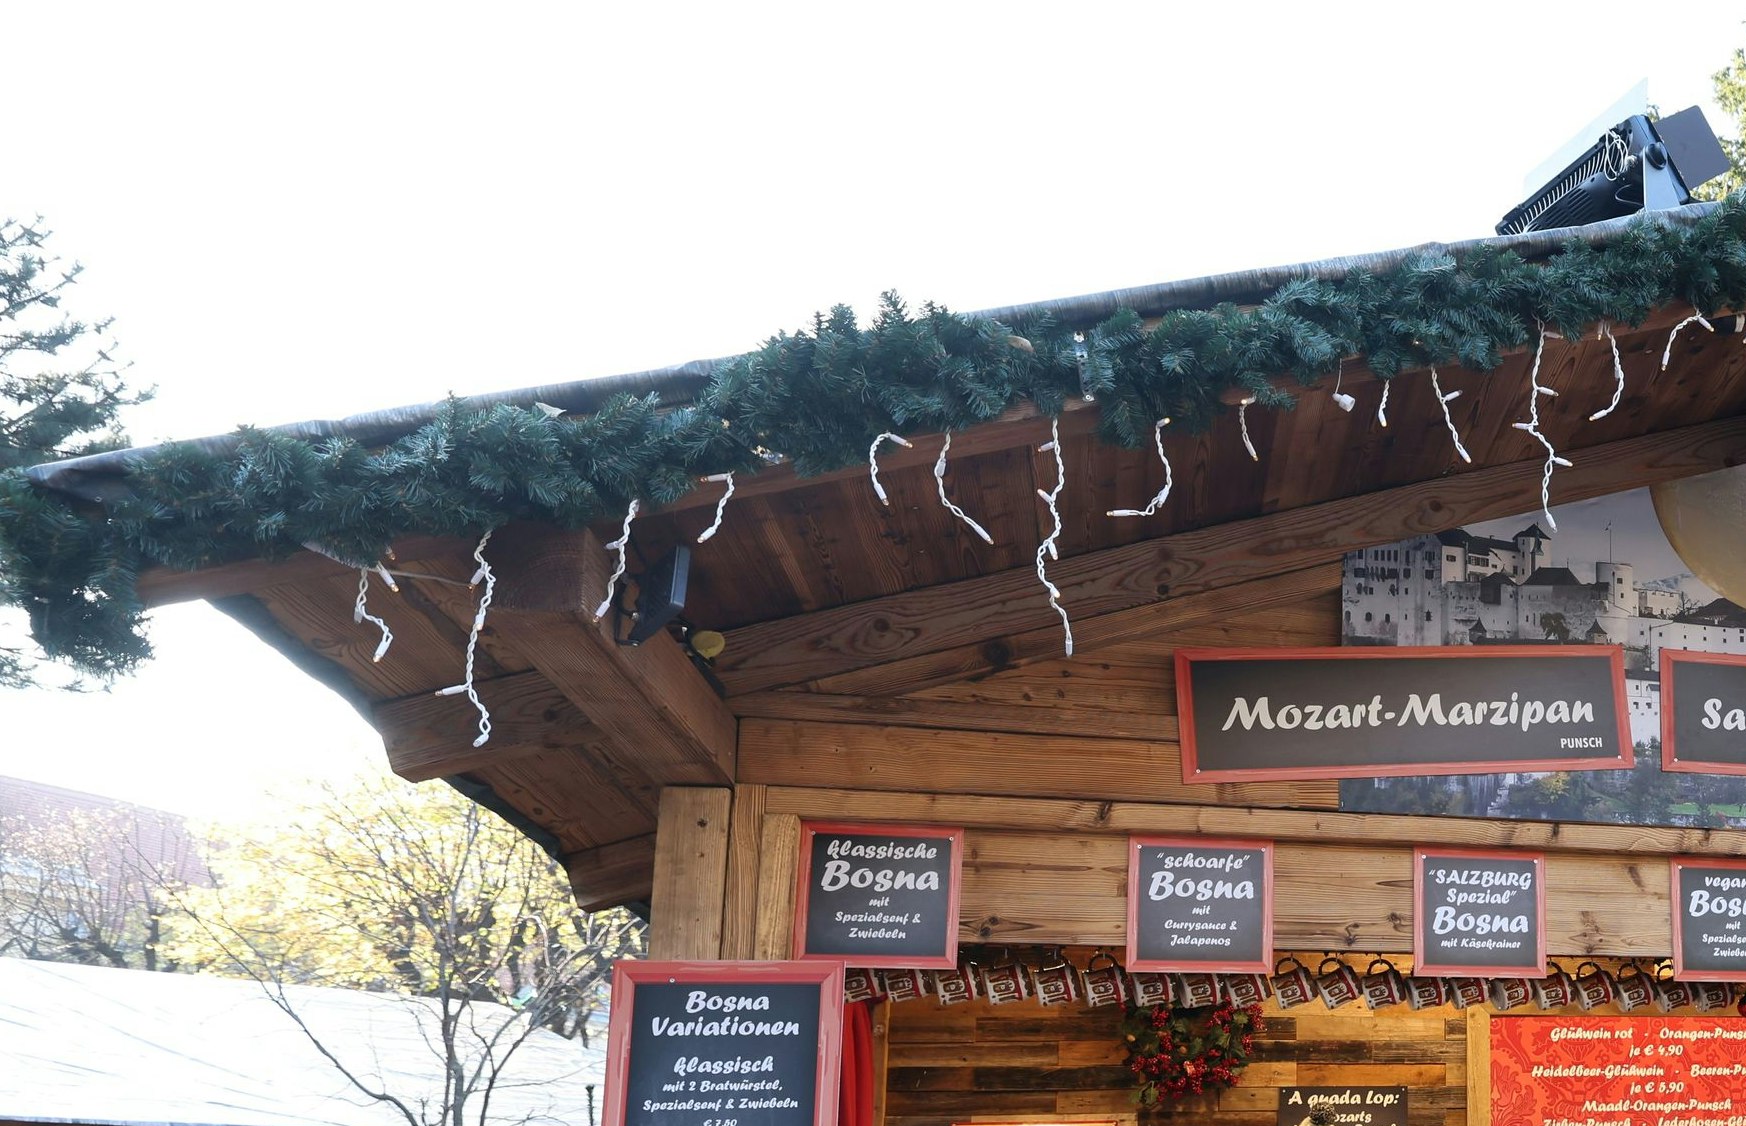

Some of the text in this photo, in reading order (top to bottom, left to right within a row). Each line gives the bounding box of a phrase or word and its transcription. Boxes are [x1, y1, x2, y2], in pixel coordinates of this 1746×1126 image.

[1222, 692, 1594, 732] Mozart-Marzipan
[1560, 737, 1602, 748] PUNSCH
[827, 840, 937, 860] klassische
[821, 860, 939, 892] Bosna
[1149, 871, 1254, 901] Bosna
[869, 896, 889, 907] mit
[1192, 905, 1210, 915] mit
[835, 911, 921, 925] Spezialsenf &
[1164, 919, 1237, 931] Currysauce &
[1433, 906, 1528, 935] Bosna
[1726, 921, 1741, 930] mit
[848, 928, 906, 939] Zwiebeln
[1170, 934, 1231, 947] Jalapenos
[1441, 938, 1521, 950] mit Käsekrainer
[685, 991, 769, 1013] Bosna
[652, 1016, 799, 1036] Variationen
[1550, 1027, 1611, 1042] Glühwein
[1615, 1028, 1633, 1039] rot
[1629, 1045, 1683, 1058] je € 4,90
[674, 1056, 773, 1077] klassisch
[1531, 1064, 1664, 1079] Heidelbeer-Glühwein
[662, 1079, 782, 1092] mit 2 Bratwürstel,
[643, 1097, 798, 1112] Spezialsenf & Zwiebeln
[1288, 1091, 1303, 1105] A
[1366, 1090, 1400, 1107] Lop:
[1581, 1098, 1732, 1114] Maadl-Orangen-Punsch
[1334, 1111, 1372, 1123] ozarts
